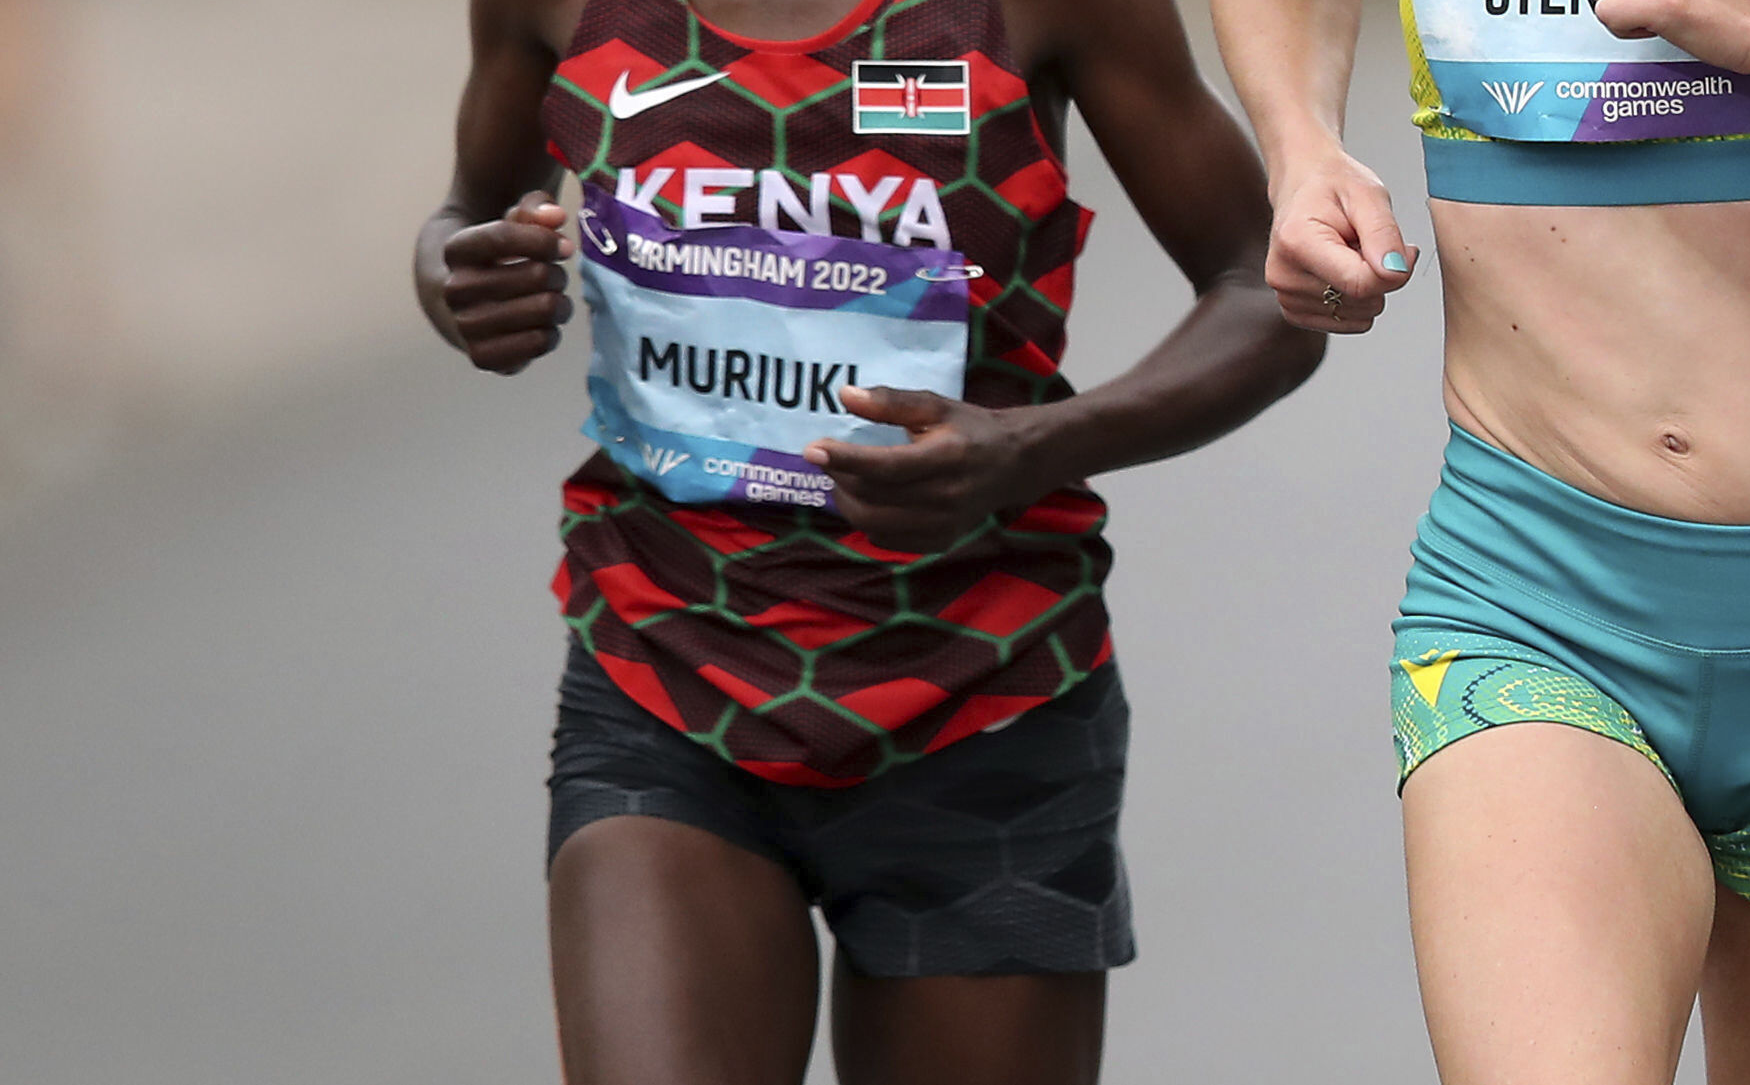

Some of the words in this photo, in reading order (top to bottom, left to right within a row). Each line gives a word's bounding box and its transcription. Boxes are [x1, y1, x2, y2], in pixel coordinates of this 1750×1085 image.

[1556, 76, 1733, 100] commonwealth
[1603, 96, 1684, 122] games
[616, 167, 952, 251] KENYA
[626, 233, 805, 289] BIRMINGHAM
[811, 260, 888, 296] 2022
[703, 457, 835, 492] commonwe
[745, 481, 827, 508] games
